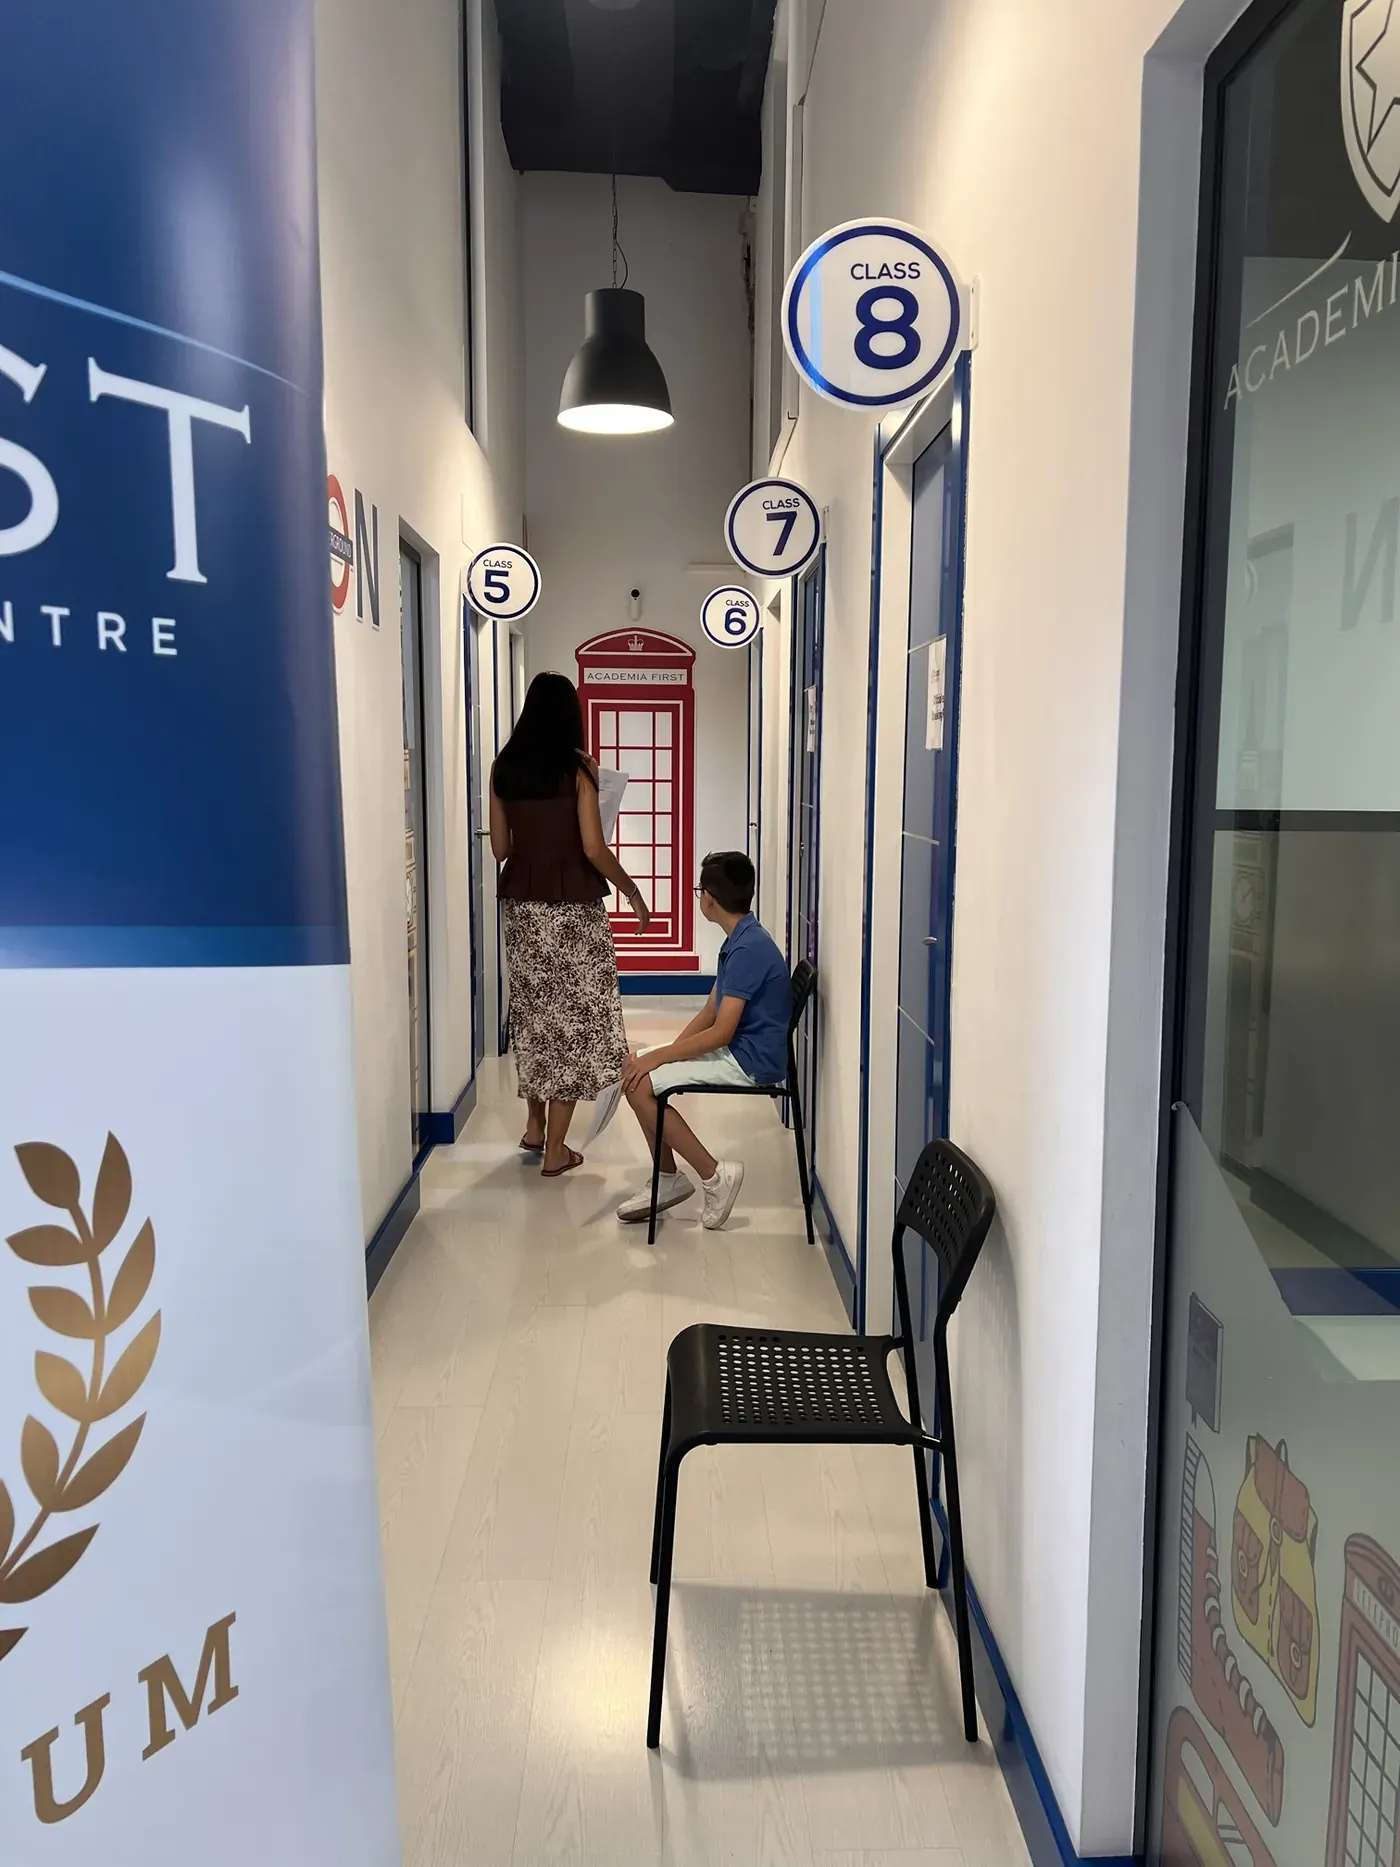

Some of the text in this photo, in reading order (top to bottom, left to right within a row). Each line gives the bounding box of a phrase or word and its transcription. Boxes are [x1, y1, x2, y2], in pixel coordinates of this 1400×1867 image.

[850, 262, 921, 280] CLASS
[853, 285, 922, 370] 8
[1223, 250, 1400, 411] ACADEMI
[762, 497, 801, 510] CLASS
[766, 510, 798, 557] 7
[483, 558, 513, 569] CLASS
[483, 569, 511, 604] 5
[725, 598, 750, 608] CLASS
[724, 607, 747, 636] 6
[586, 672, 685, 681] ACADEMIA FIRST
[20, 1610, 239, 1825] UM
